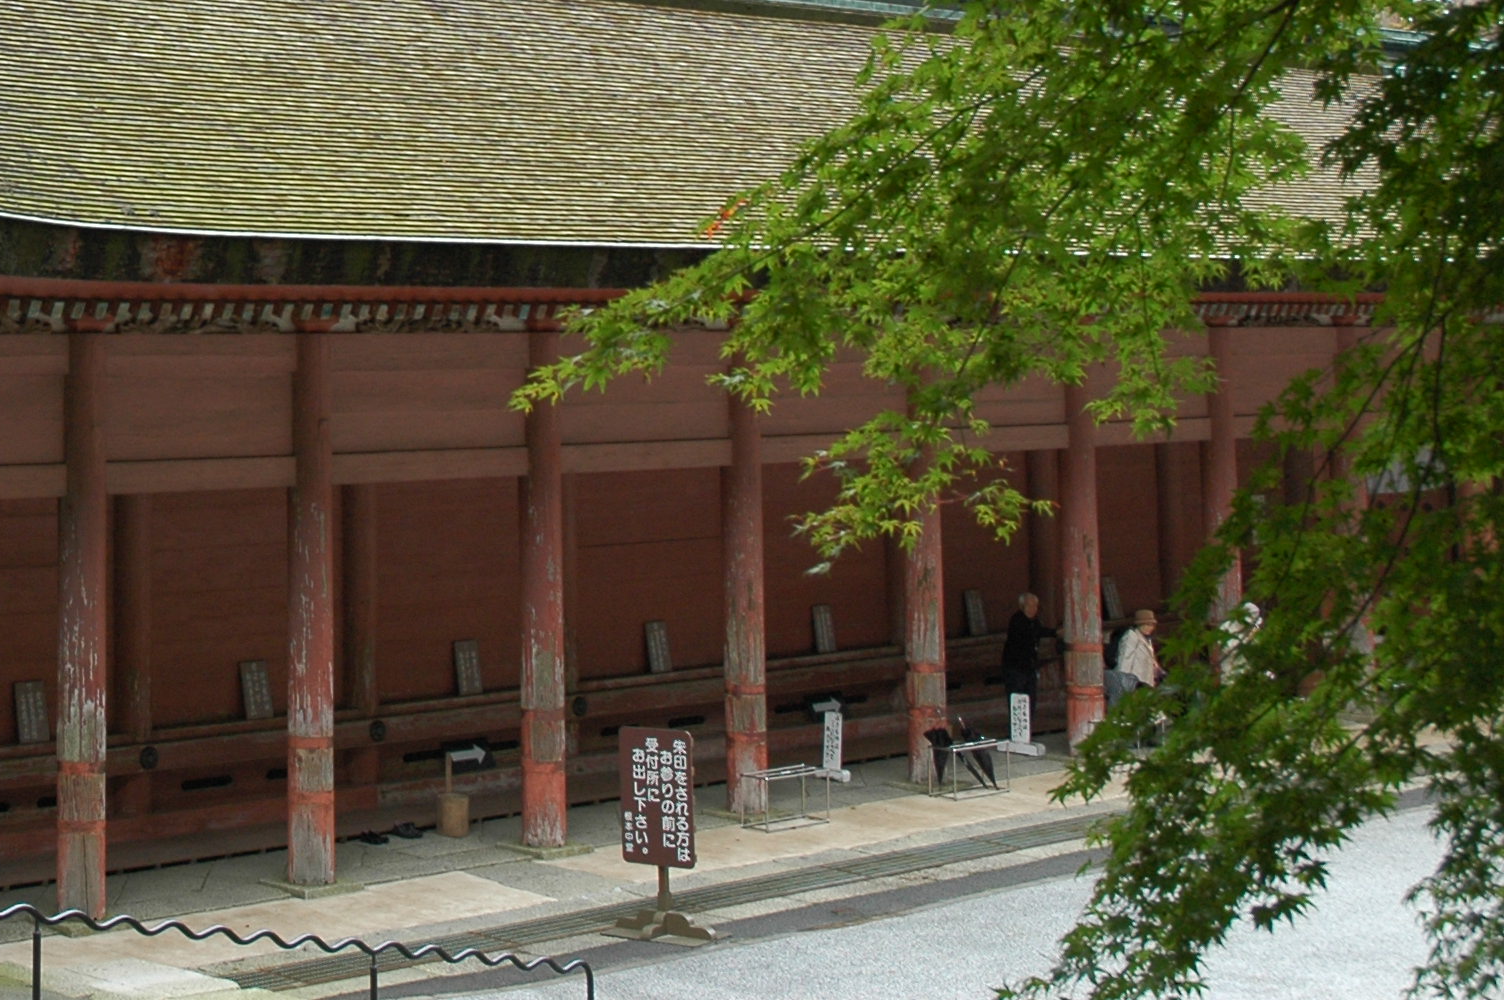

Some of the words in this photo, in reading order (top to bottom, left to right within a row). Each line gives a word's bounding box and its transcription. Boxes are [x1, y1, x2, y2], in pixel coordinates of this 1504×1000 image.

[632, 748, 649, 855] お出し下さい。
[645, 737, 660, 803] 受付所に
[660, 750, 676, 848] お参りの前に
[673, 739, 691, 862] 朱印をされる方は
